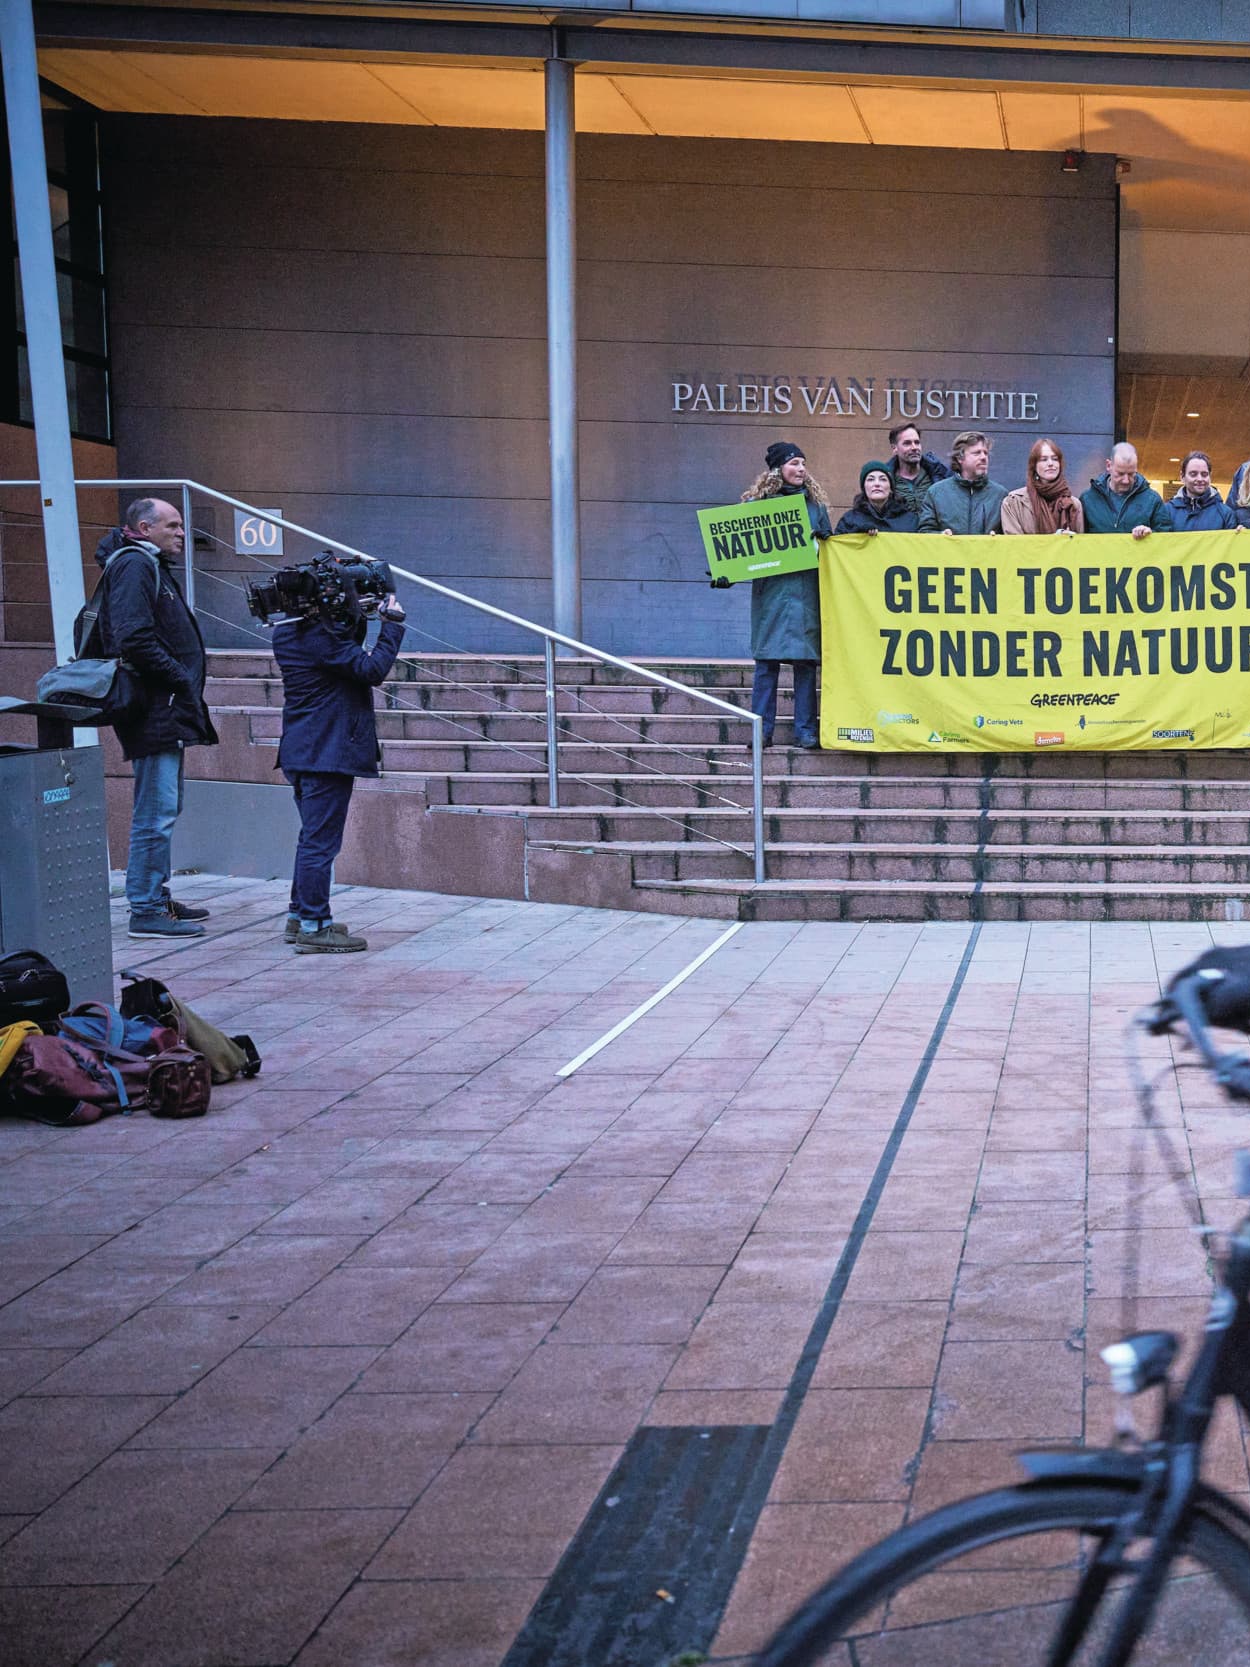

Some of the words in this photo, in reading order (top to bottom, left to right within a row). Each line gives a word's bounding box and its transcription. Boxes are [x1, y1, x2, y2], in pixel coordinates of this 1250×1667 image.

[672, 383, 793, 414] PALEIS
[798, 386, 874, 416] VAN
[881, 388, 1039, 421] JUSTITIE
[240, 516, 277, 547] 60
[709, 514, 771, 536] BESCHERM
[773, 509, 802, 525] ONZE
[711, 522, 807, 562] NATUUR
[883, 565, 998, 614] GEEN
[879, 628, 1062, 677] ZONDER
[1030, 693, 1120, 708] GREENPEACE
[986, 718, 1009, 727] Caring
